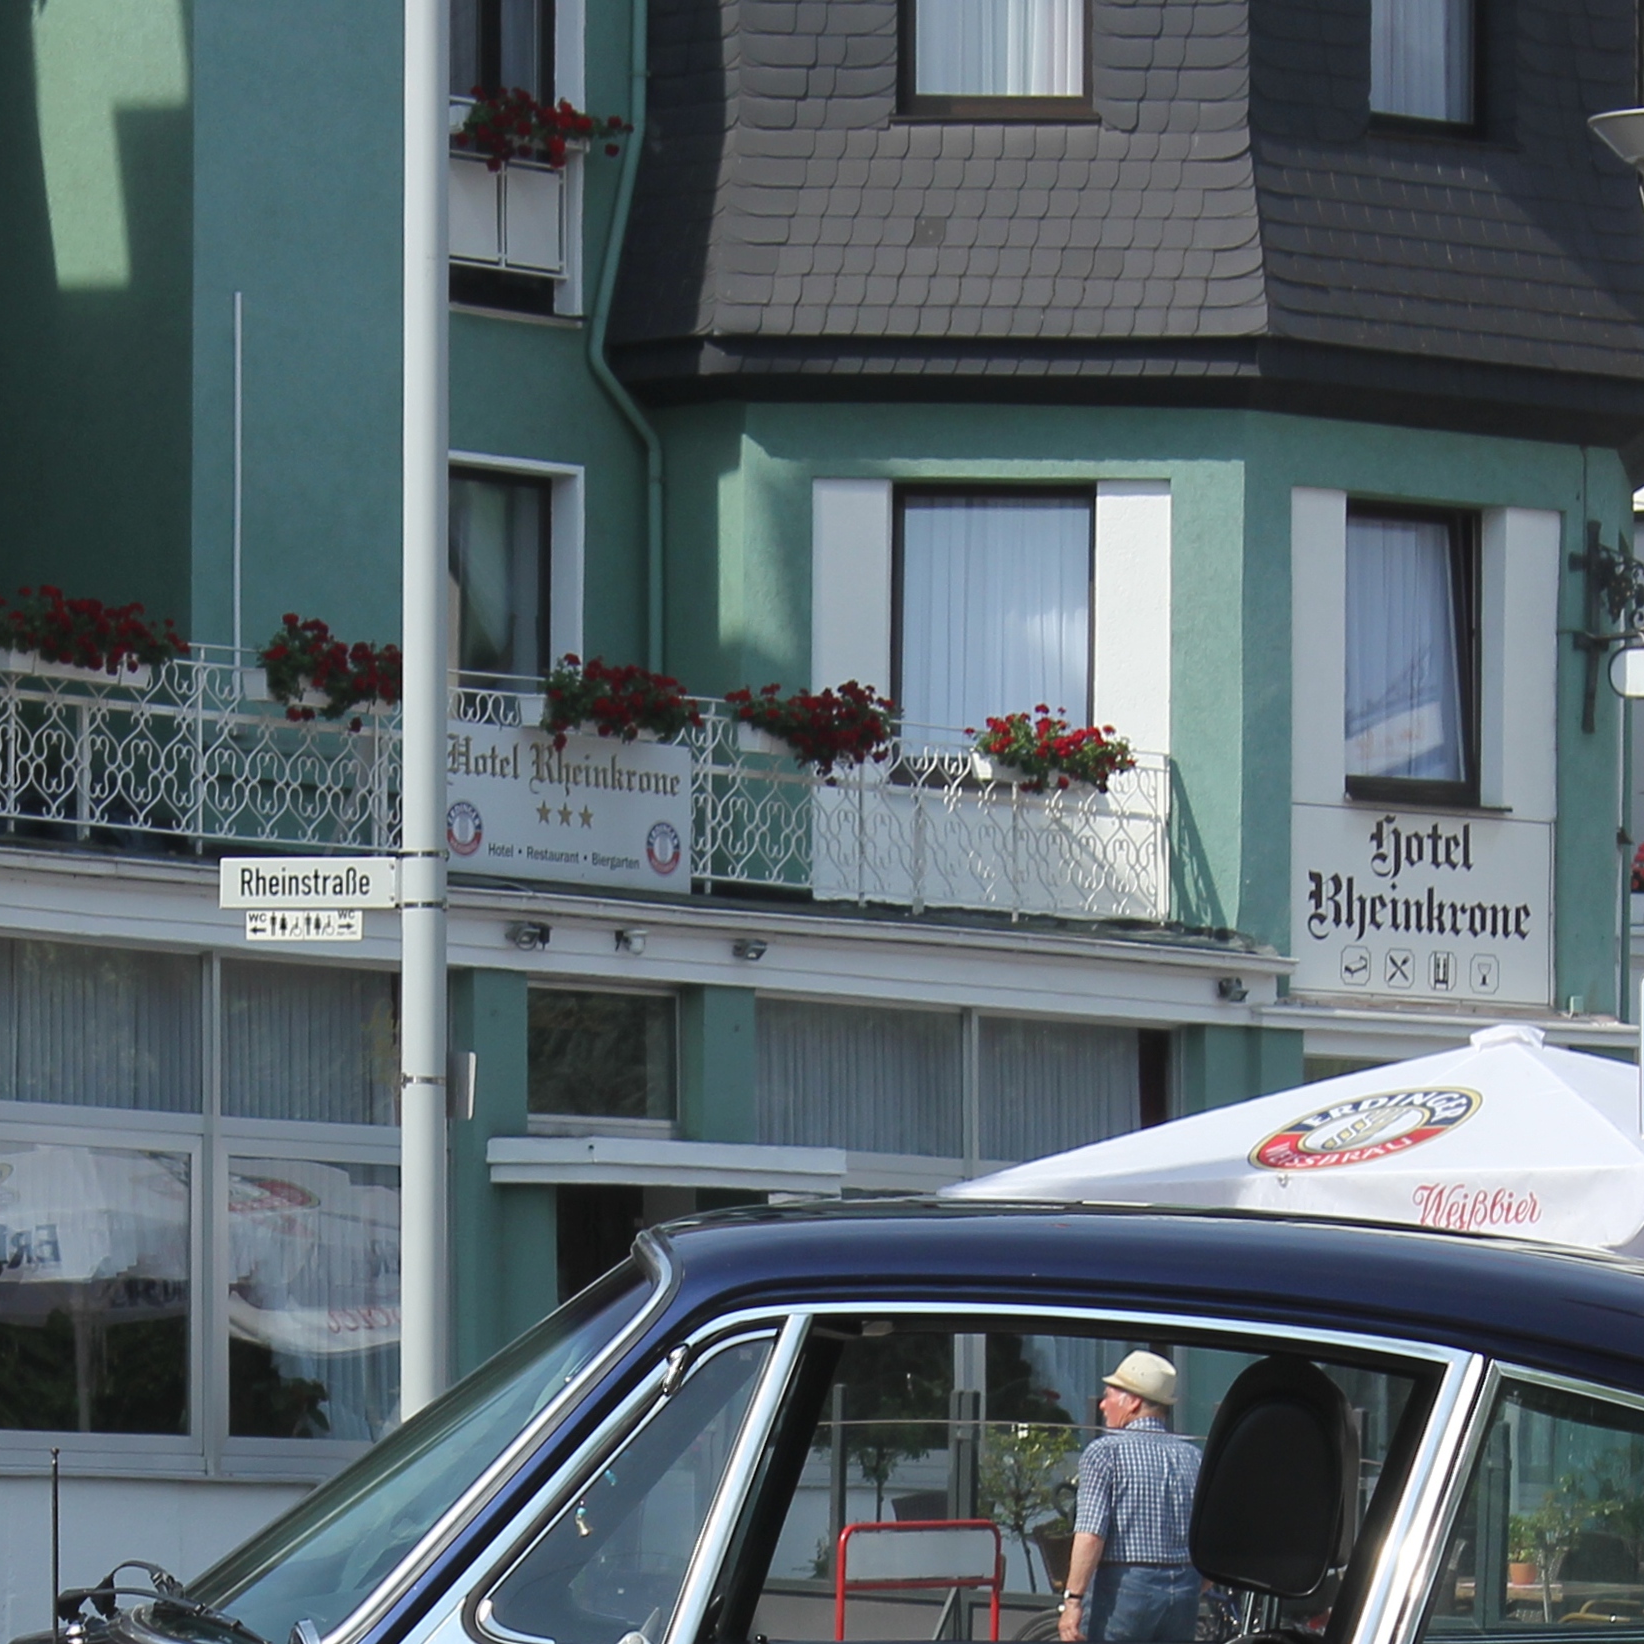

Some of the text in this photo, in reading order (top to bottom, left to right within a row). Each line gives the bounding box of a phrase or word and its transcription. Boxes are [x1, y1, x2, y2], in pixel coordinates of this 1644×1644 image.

[529, 742, 681, 797] Rheinkrone
[488, 843, 514, 858] Hotel
[526, 846, 580, 864] Restaurant
[591, 854, 640, 871] Biergarten
[1369, 814, 1474, 879] Hotel
[240, 866, 371, 897] Rheinstraße
[248, 909, 356, 923] WC WC
[1307, 869, 1532, 942] Rheinkrone
[1303, 1091, 1469, 1127] ERDINGER
[1412, 1182, 1542, 1232] Weißbier
